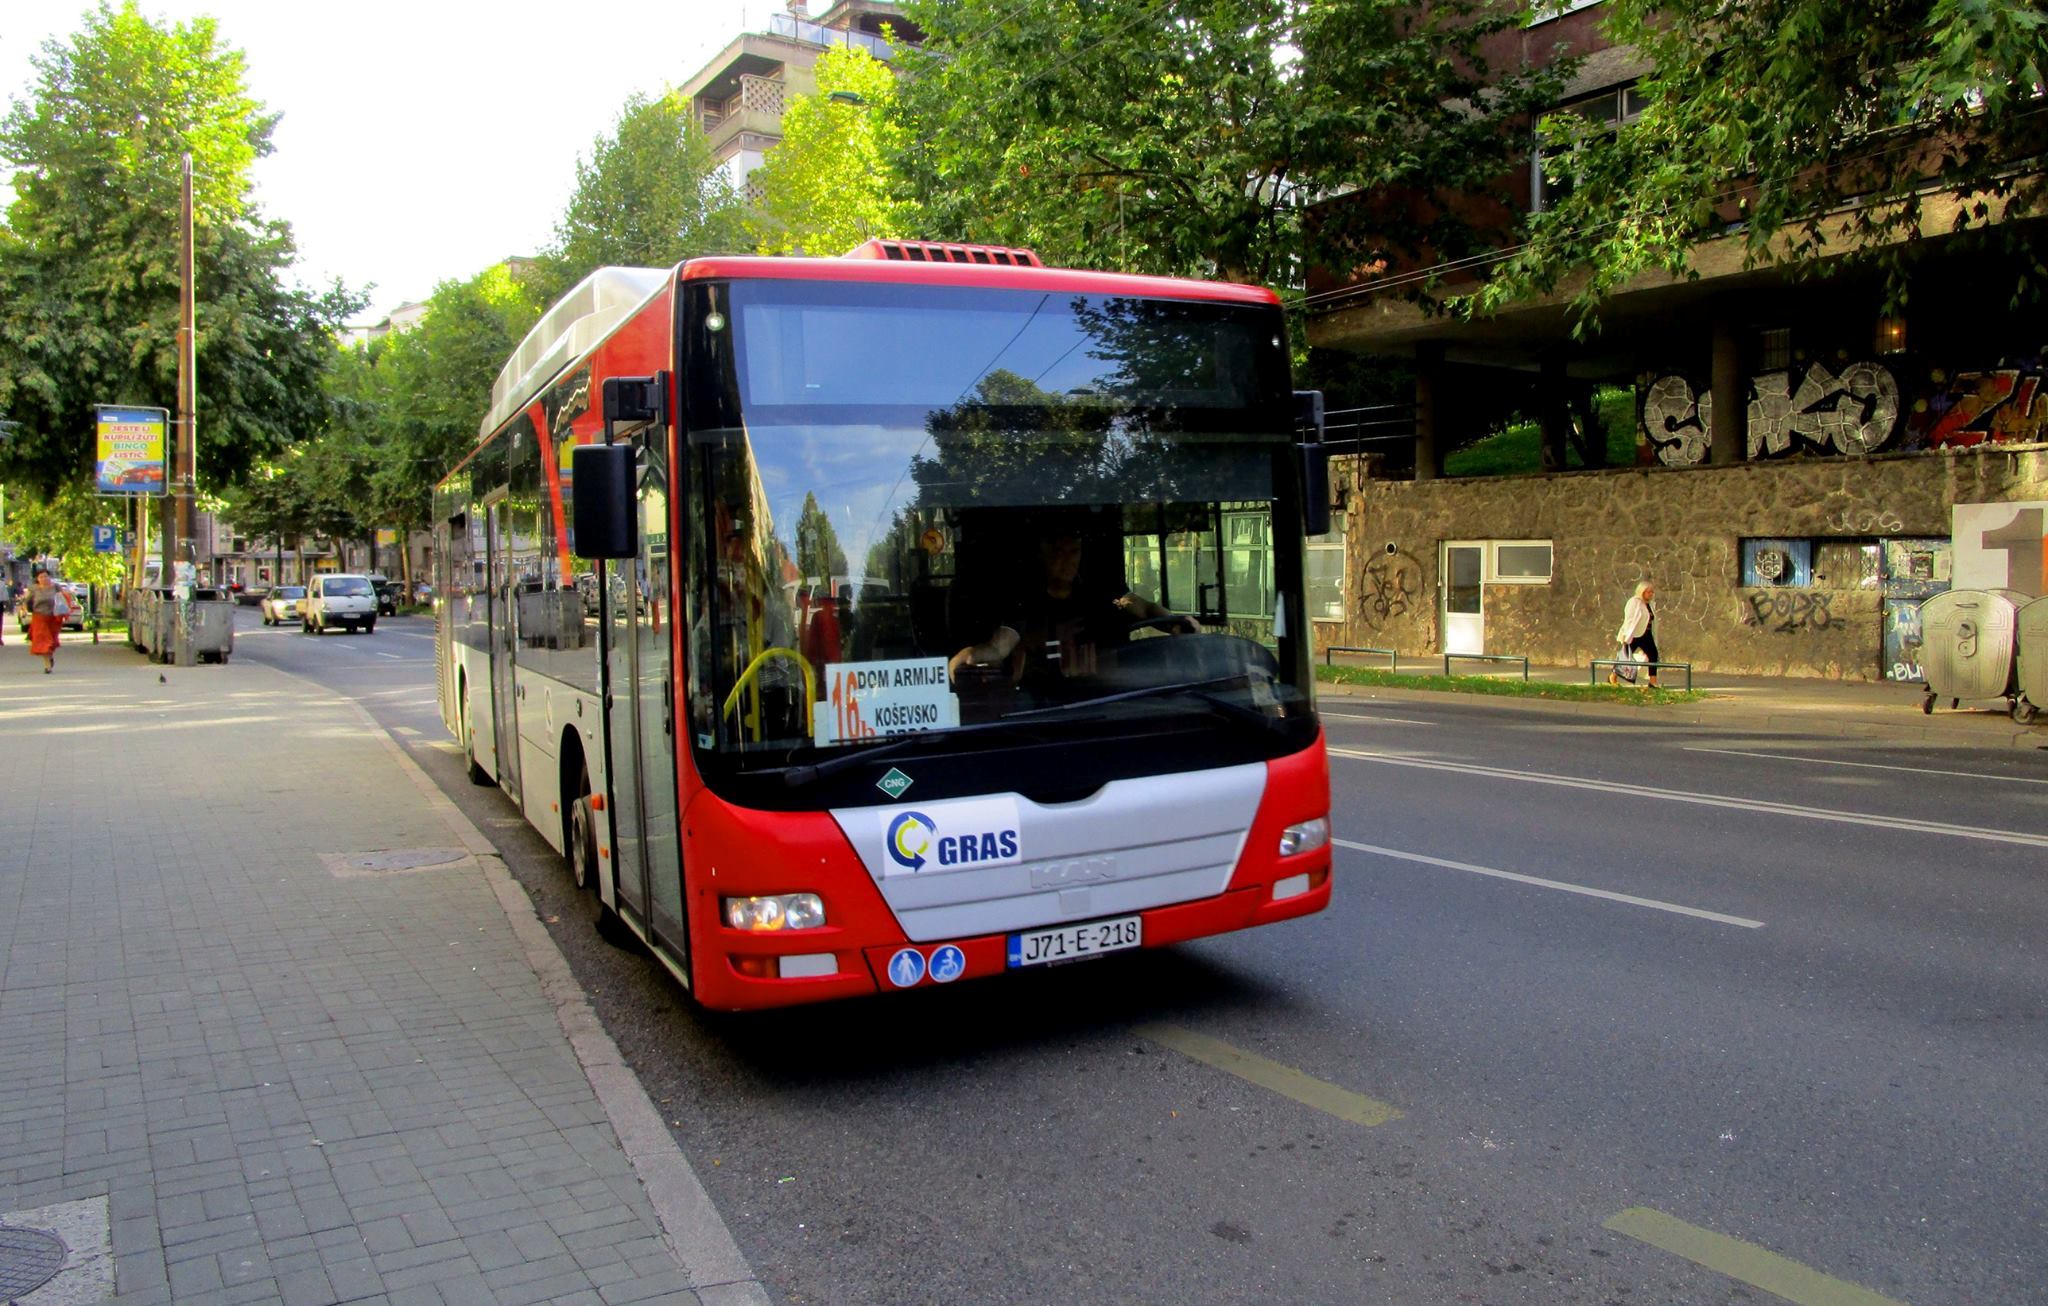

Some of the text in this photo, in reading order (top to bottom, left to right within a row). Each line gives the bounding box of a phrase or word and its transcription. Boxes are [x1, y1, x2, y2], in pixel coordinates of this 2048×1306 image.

[98, 527, 112, 543] P
[126, 532, 136, 542] P
[858, 666, 945, 690] DOM ARMIJE
[875, 703, 938, 727] KOŠEVSKO
[885, 778, 905, 788] CNG
[938, 830, 1018, 865] GRAS
[1026, 921, 1137, 960] J71-E-218
